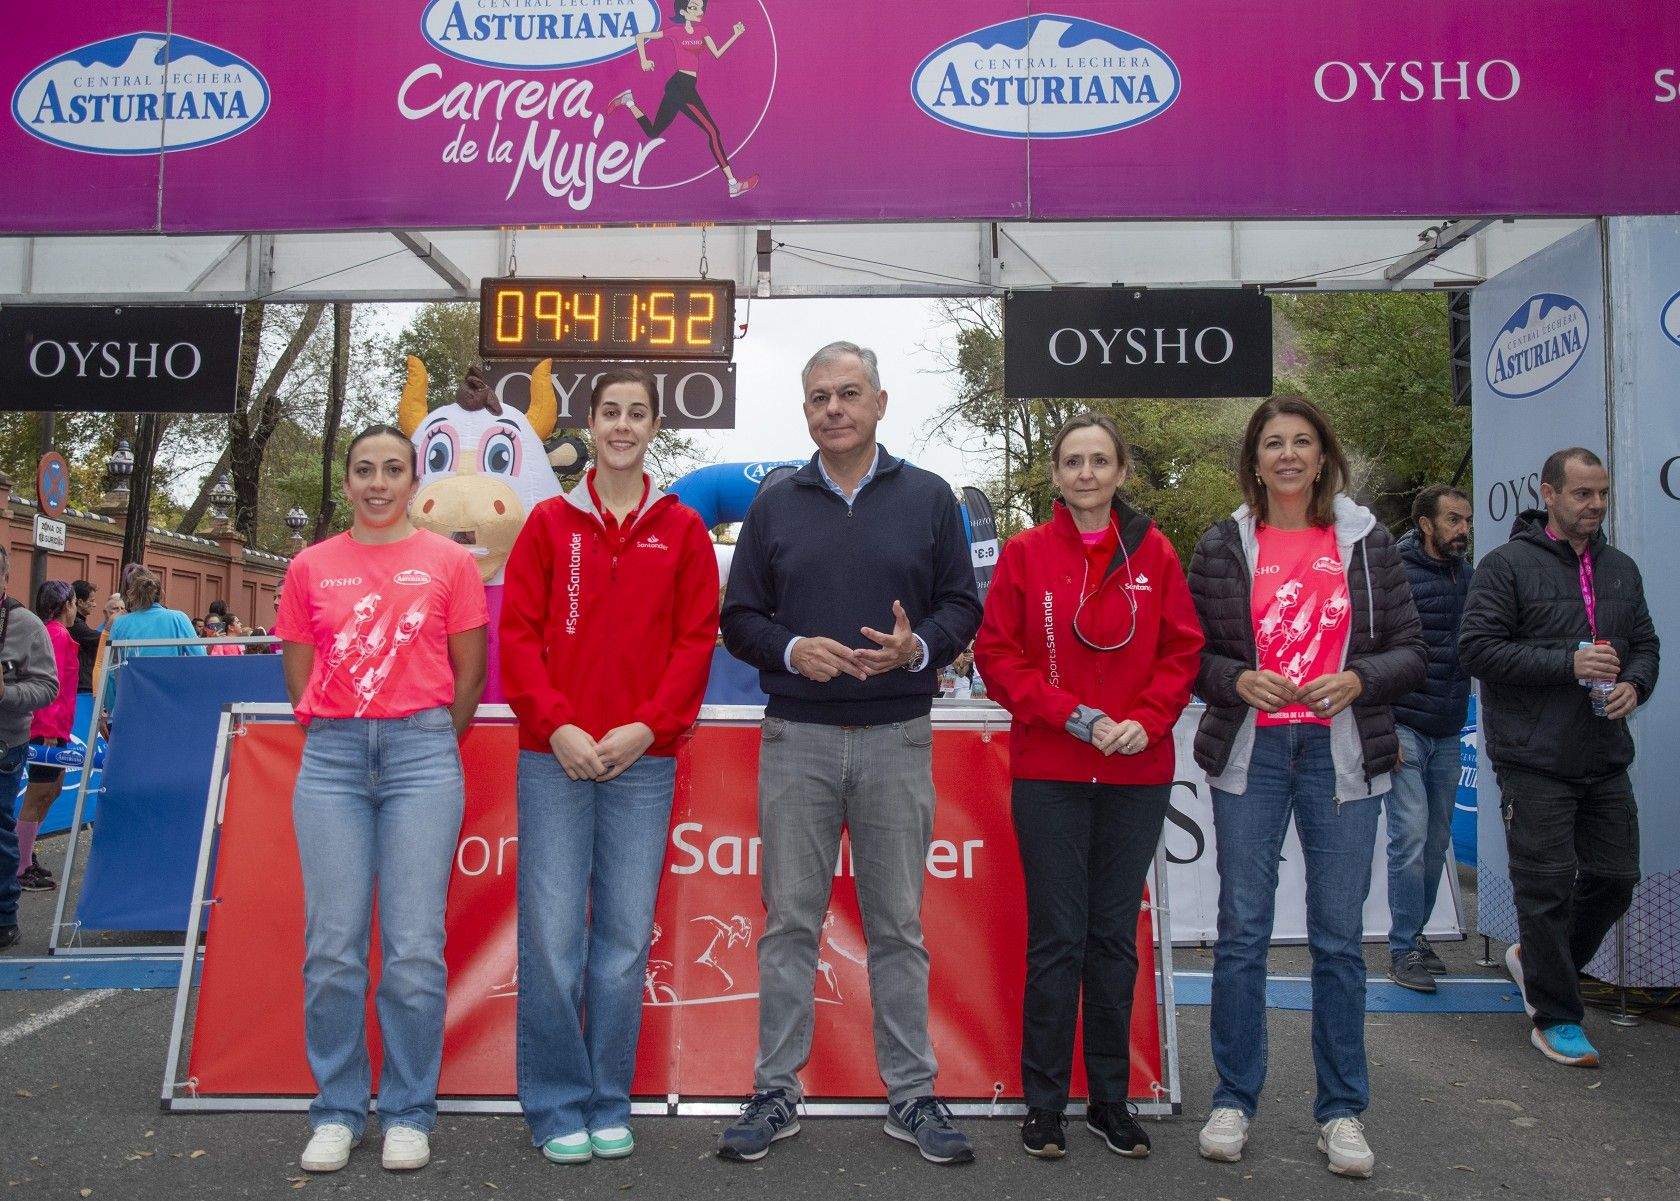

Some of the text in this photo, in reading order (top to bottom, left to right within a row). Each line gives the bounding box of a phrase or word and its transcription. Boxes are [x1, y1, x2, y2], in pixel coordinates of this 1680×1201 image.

[439, 1, 641, 41] ASTURIANA
[73, 73, 243, 88] CENTRAL LECHERA
[932, 61, 1160, 107] ASTURIANA
[974, 56, 1150, 70] CENTRAL LECHERA
[1314, 60, 1521, 103] OYSHO
[32, 80, 249, 124] ASTURIANA
[397, 63, 593, 121] Carrera
[442, 113, 666, 211] de la Mujer
[29, 341, 202, 379] OYSHO
[1048, 326, 1235, 366] OYSHO
[1493, 326, 1582, 384] ASTURIANA
[494, 371, 724, 420] OYO
[1488, 472, 1542, 521] OYS
[636, 541, 669, 551] Santander
[320, 576, 363, 589] OYSHO
[565, 532, 582, 635] #SportSantander
